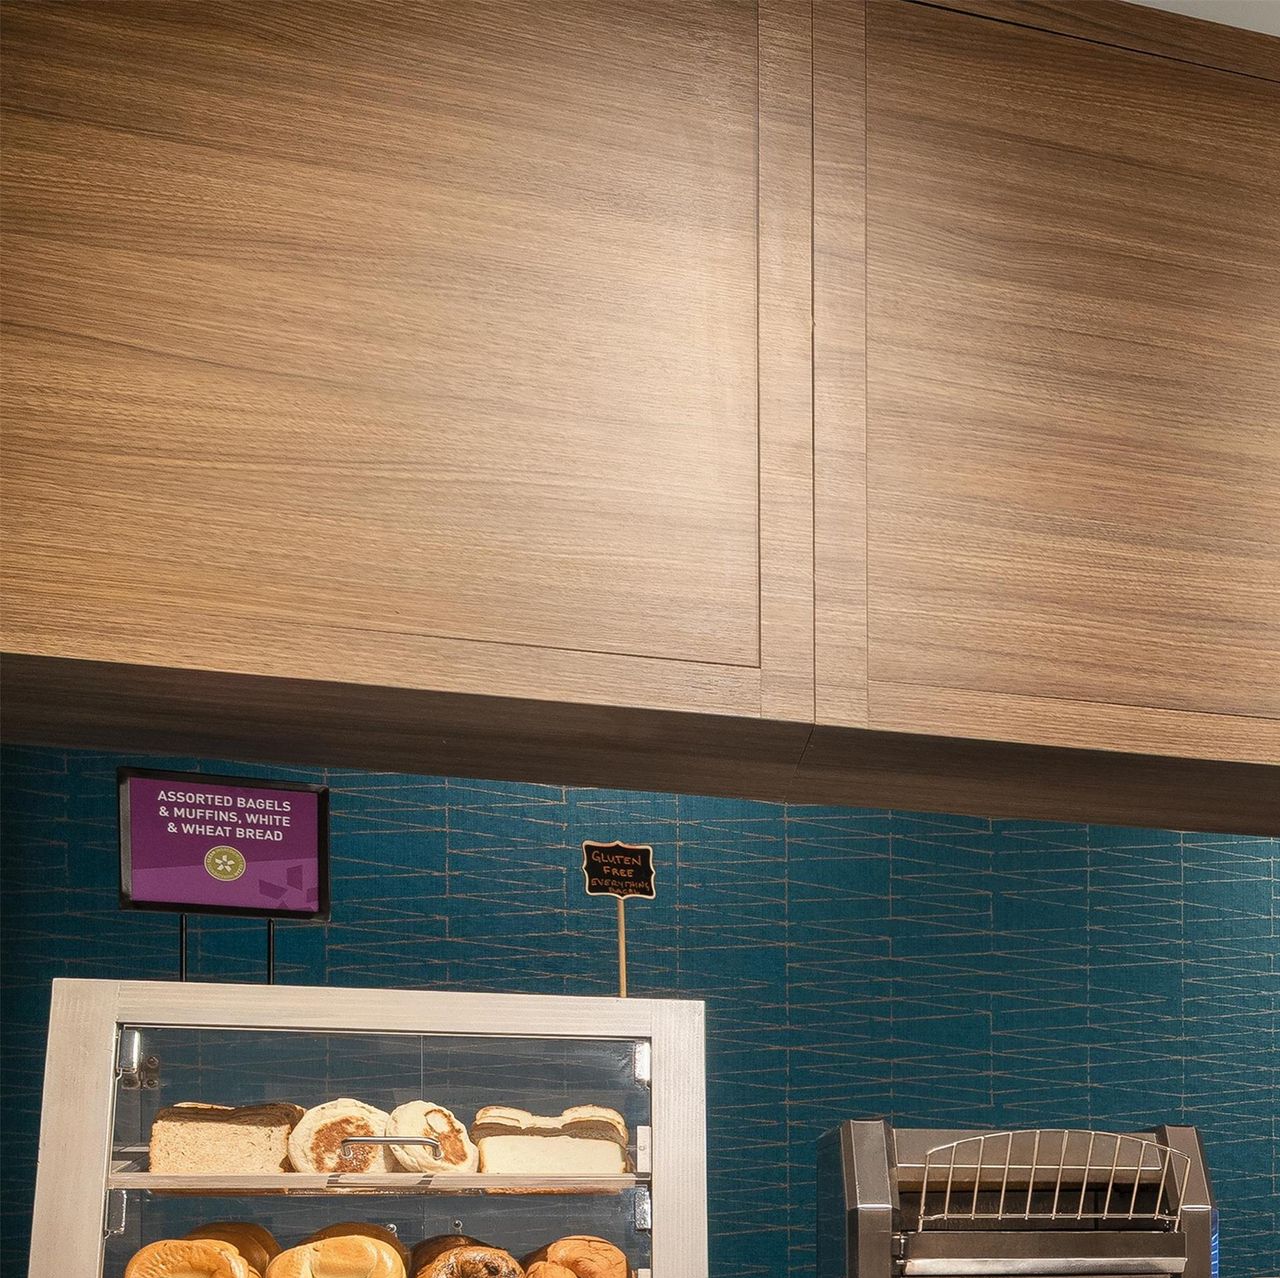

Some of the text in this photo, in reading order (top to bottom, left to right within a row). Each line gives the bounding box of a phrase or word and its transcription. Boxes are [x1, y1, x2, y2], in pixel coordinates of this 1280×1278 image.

[157, 790, 291, 812] ASSORTED BAGELS
[159, 805, 291, 827] & MUFFINS, WHITE
[167, 822, 283, 842] & WHEAT BREAD
[591, 850, 642, 866] GLUTEN
[603, 865, 634, 878] FREE
